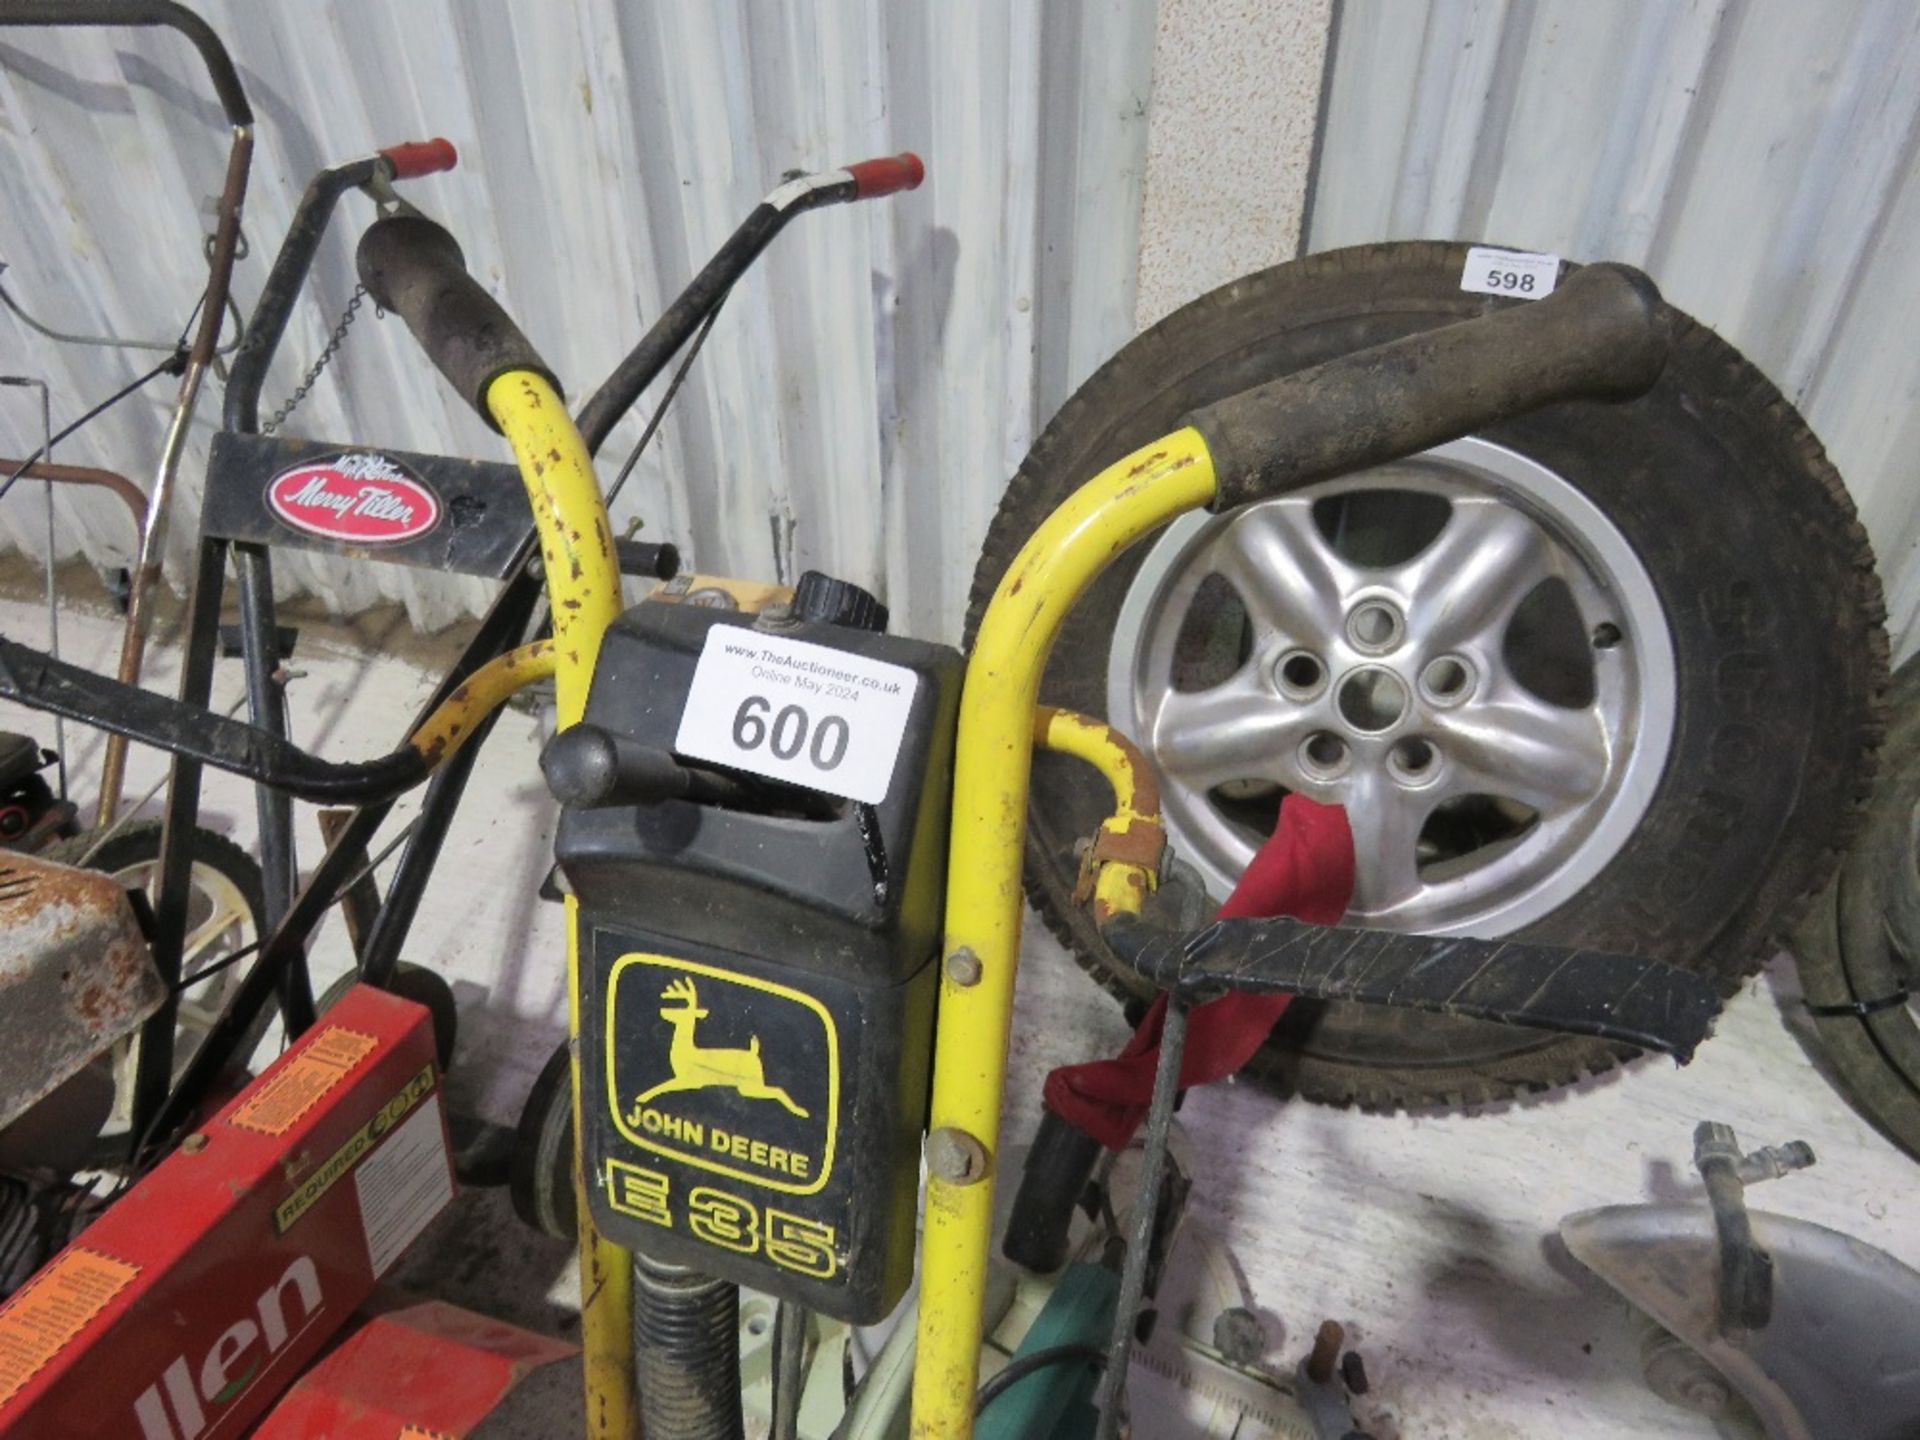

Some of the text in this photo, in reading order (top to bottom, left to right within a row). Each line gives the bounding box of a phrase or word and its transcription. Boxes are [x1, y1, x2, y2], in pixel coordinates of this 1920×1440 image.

[1486, 270, 1535, 292] 598
[283, 475, 414, 523] Merry Tiller
[724, 643, 901, 696] www.TheAuctioneer.co.uk
[751, 664, 861, 703] Online May 2024
[732, 694, 850, 771] 600
[626, 1104, 810, 1179] JOHN DEERE
[281, 1137, 365, 1223] REQUIRED
[605, 1156, 837, 1279] E35
[133, 1255, 324, 1440] llen
